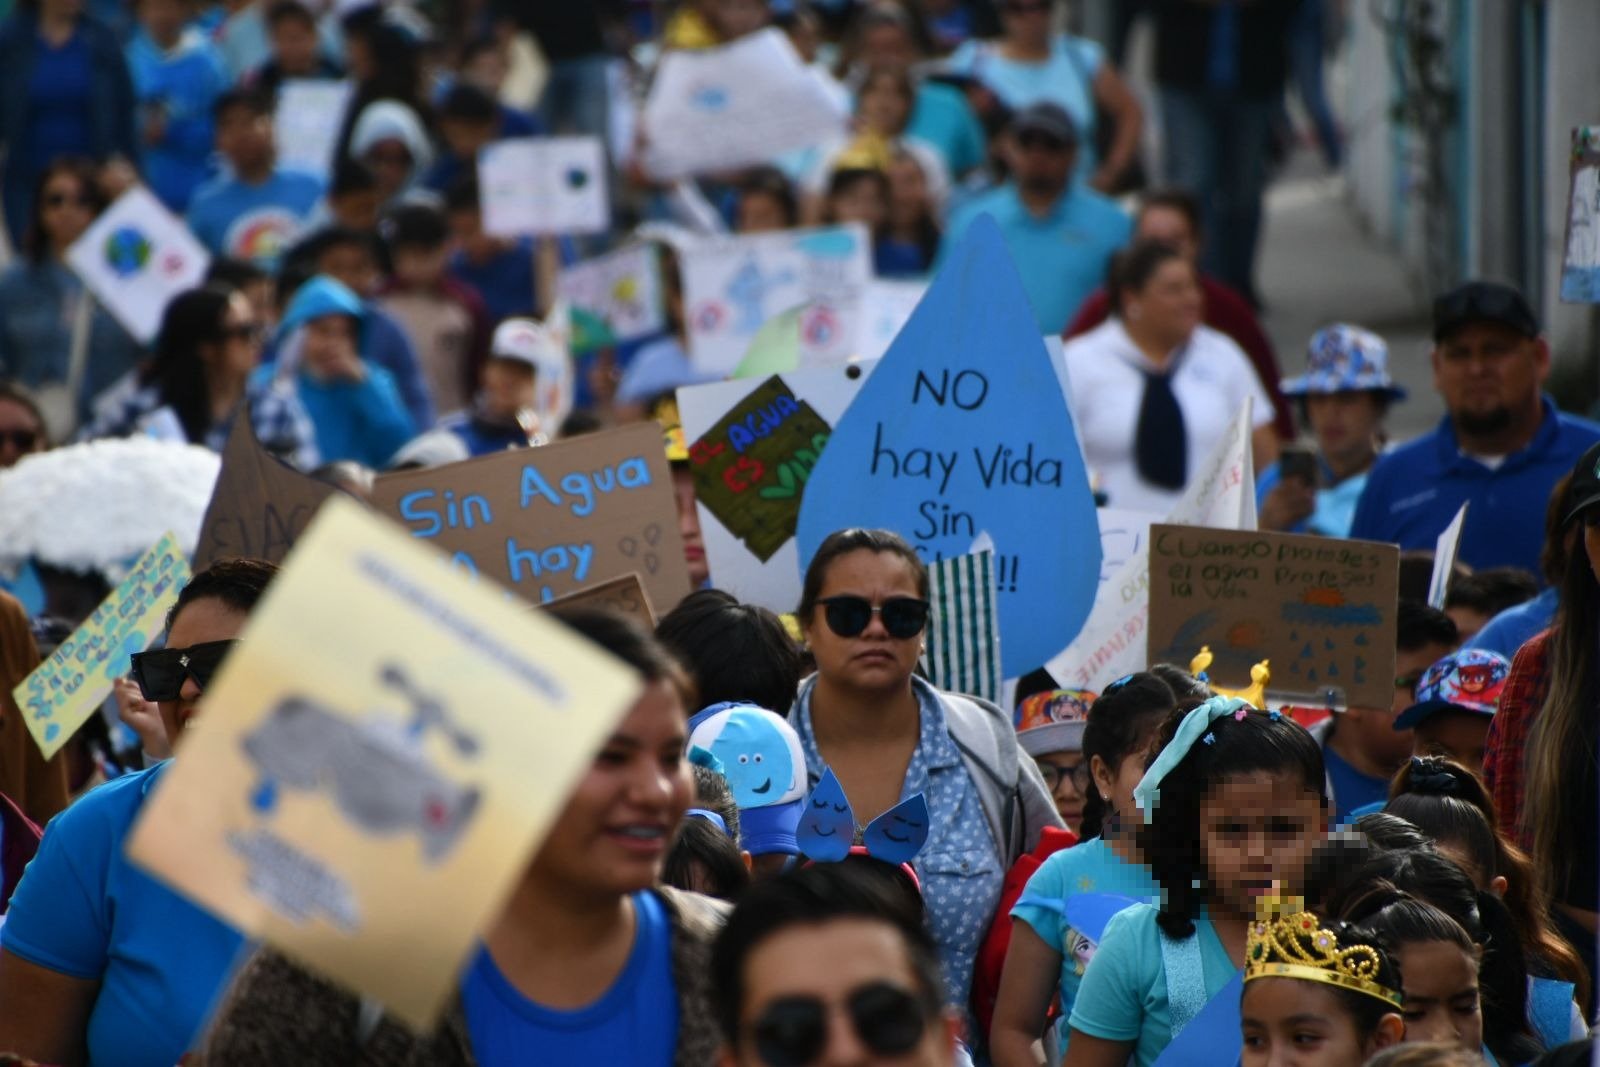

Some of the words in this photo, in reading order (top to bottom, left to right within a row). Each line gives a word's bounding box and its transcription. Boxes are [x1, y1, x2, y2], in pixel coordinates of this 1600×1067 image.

[911, 368, 989, 411] NO
[871, 421, 958, 495] hay
[973, 442, 1062, 490] Vida
[399, 488, 493, 537] Sin
[519, 456, 652, 516] Agua
[914, 500, 974, 541] Sin
[506, 536, 593, 582] hay
